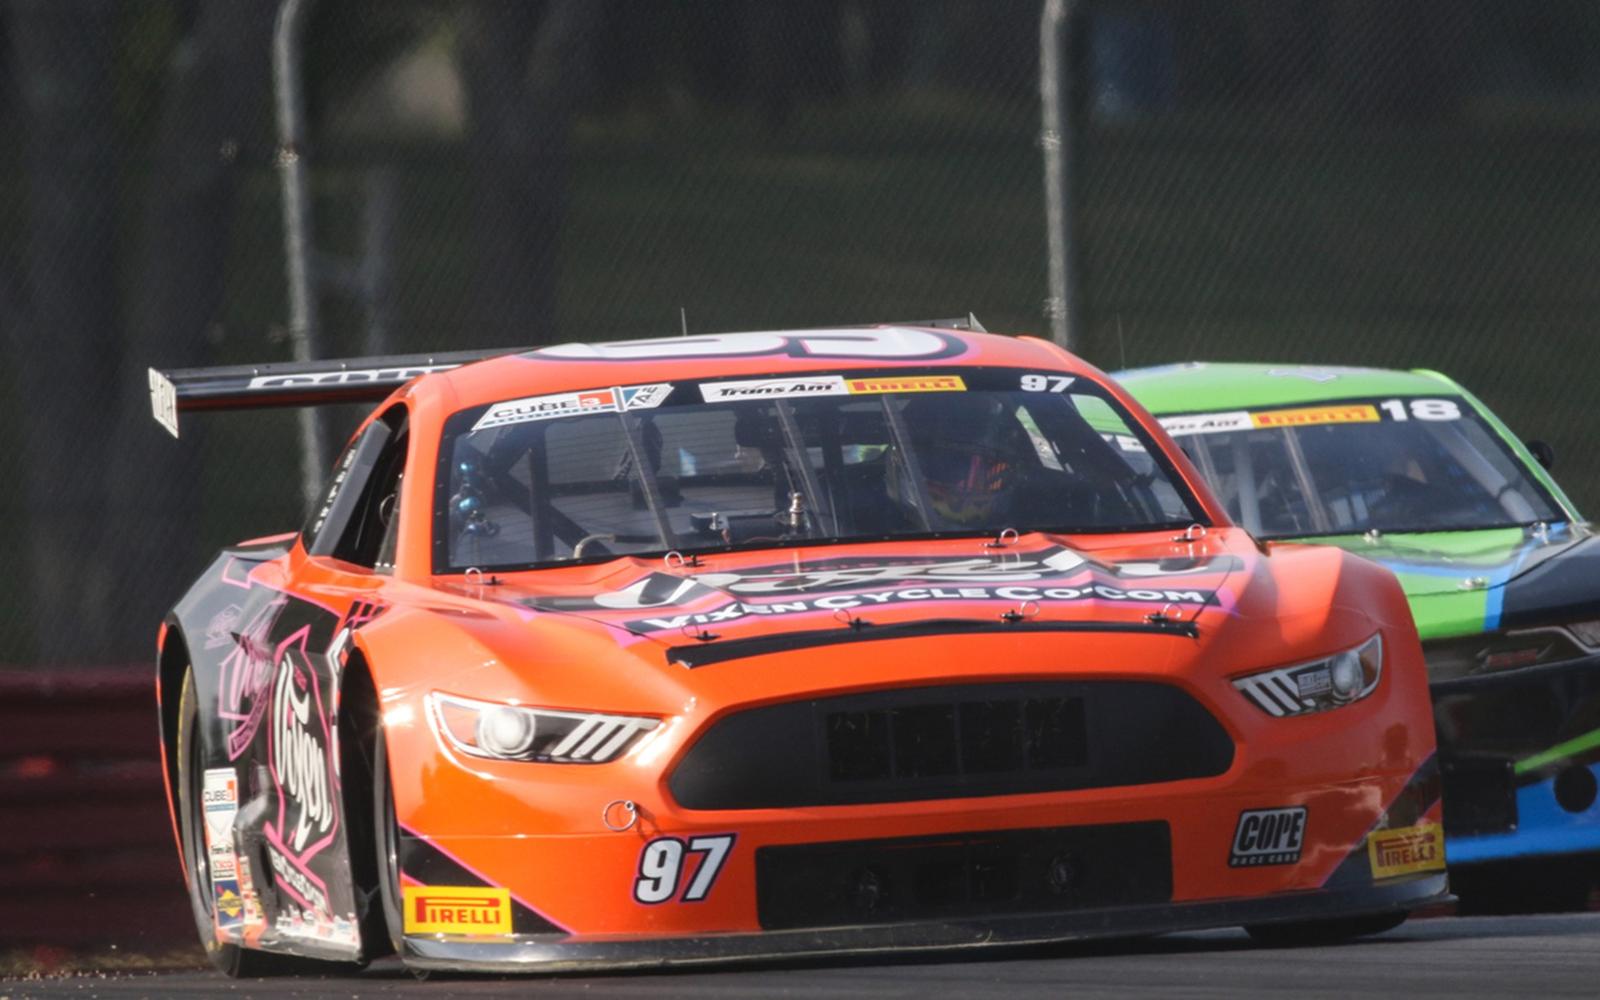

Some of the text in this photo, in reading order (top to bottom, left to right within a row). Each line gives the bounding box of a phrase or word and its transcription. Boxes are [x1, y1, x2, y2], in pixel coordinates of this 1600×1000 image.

[719, 382, 833, 397] Trans Am
[851, 377, 957, 392] PIRELLI
[1019, 373, 1076, 394] 97
[1380, 398, 1461, 422] 18
[1236, 811, 1304, 852] COPE
[1375, 831, 1437, 868] PIRELLI
[633, 834, 738, 904] 97
[415, 896, 501, 925] PIRELLI
